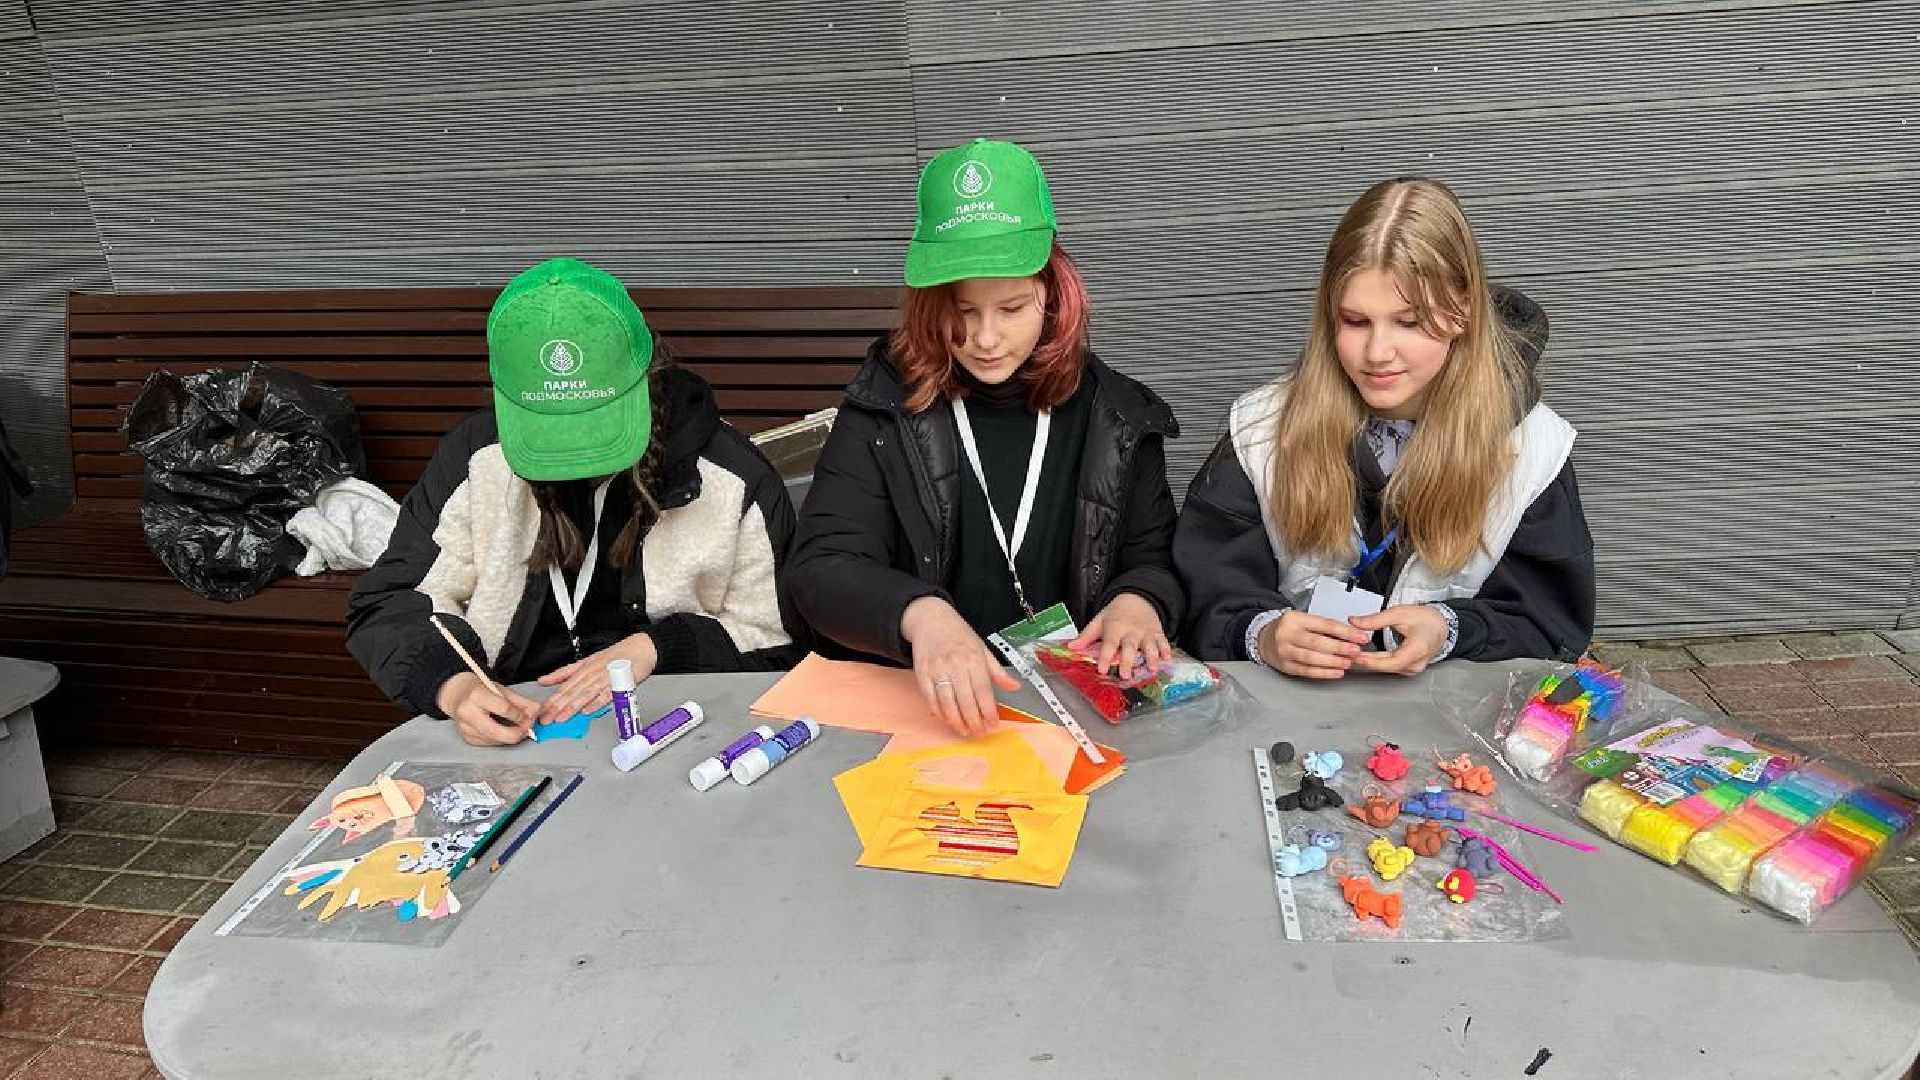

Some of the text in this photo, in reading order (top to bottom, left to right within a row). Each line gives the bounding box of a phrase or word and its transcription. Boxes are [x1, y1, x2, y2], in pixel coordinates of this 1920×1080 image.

[956, 201, 994, 215] ПАРКИ
[935, 212, 1022, 235] ПОДМОСКОВЬЯ
[543, 380, 587, 391] ПАРКИ
[521, 387, 616, 401] ПОДМОСКОВЬЯ
